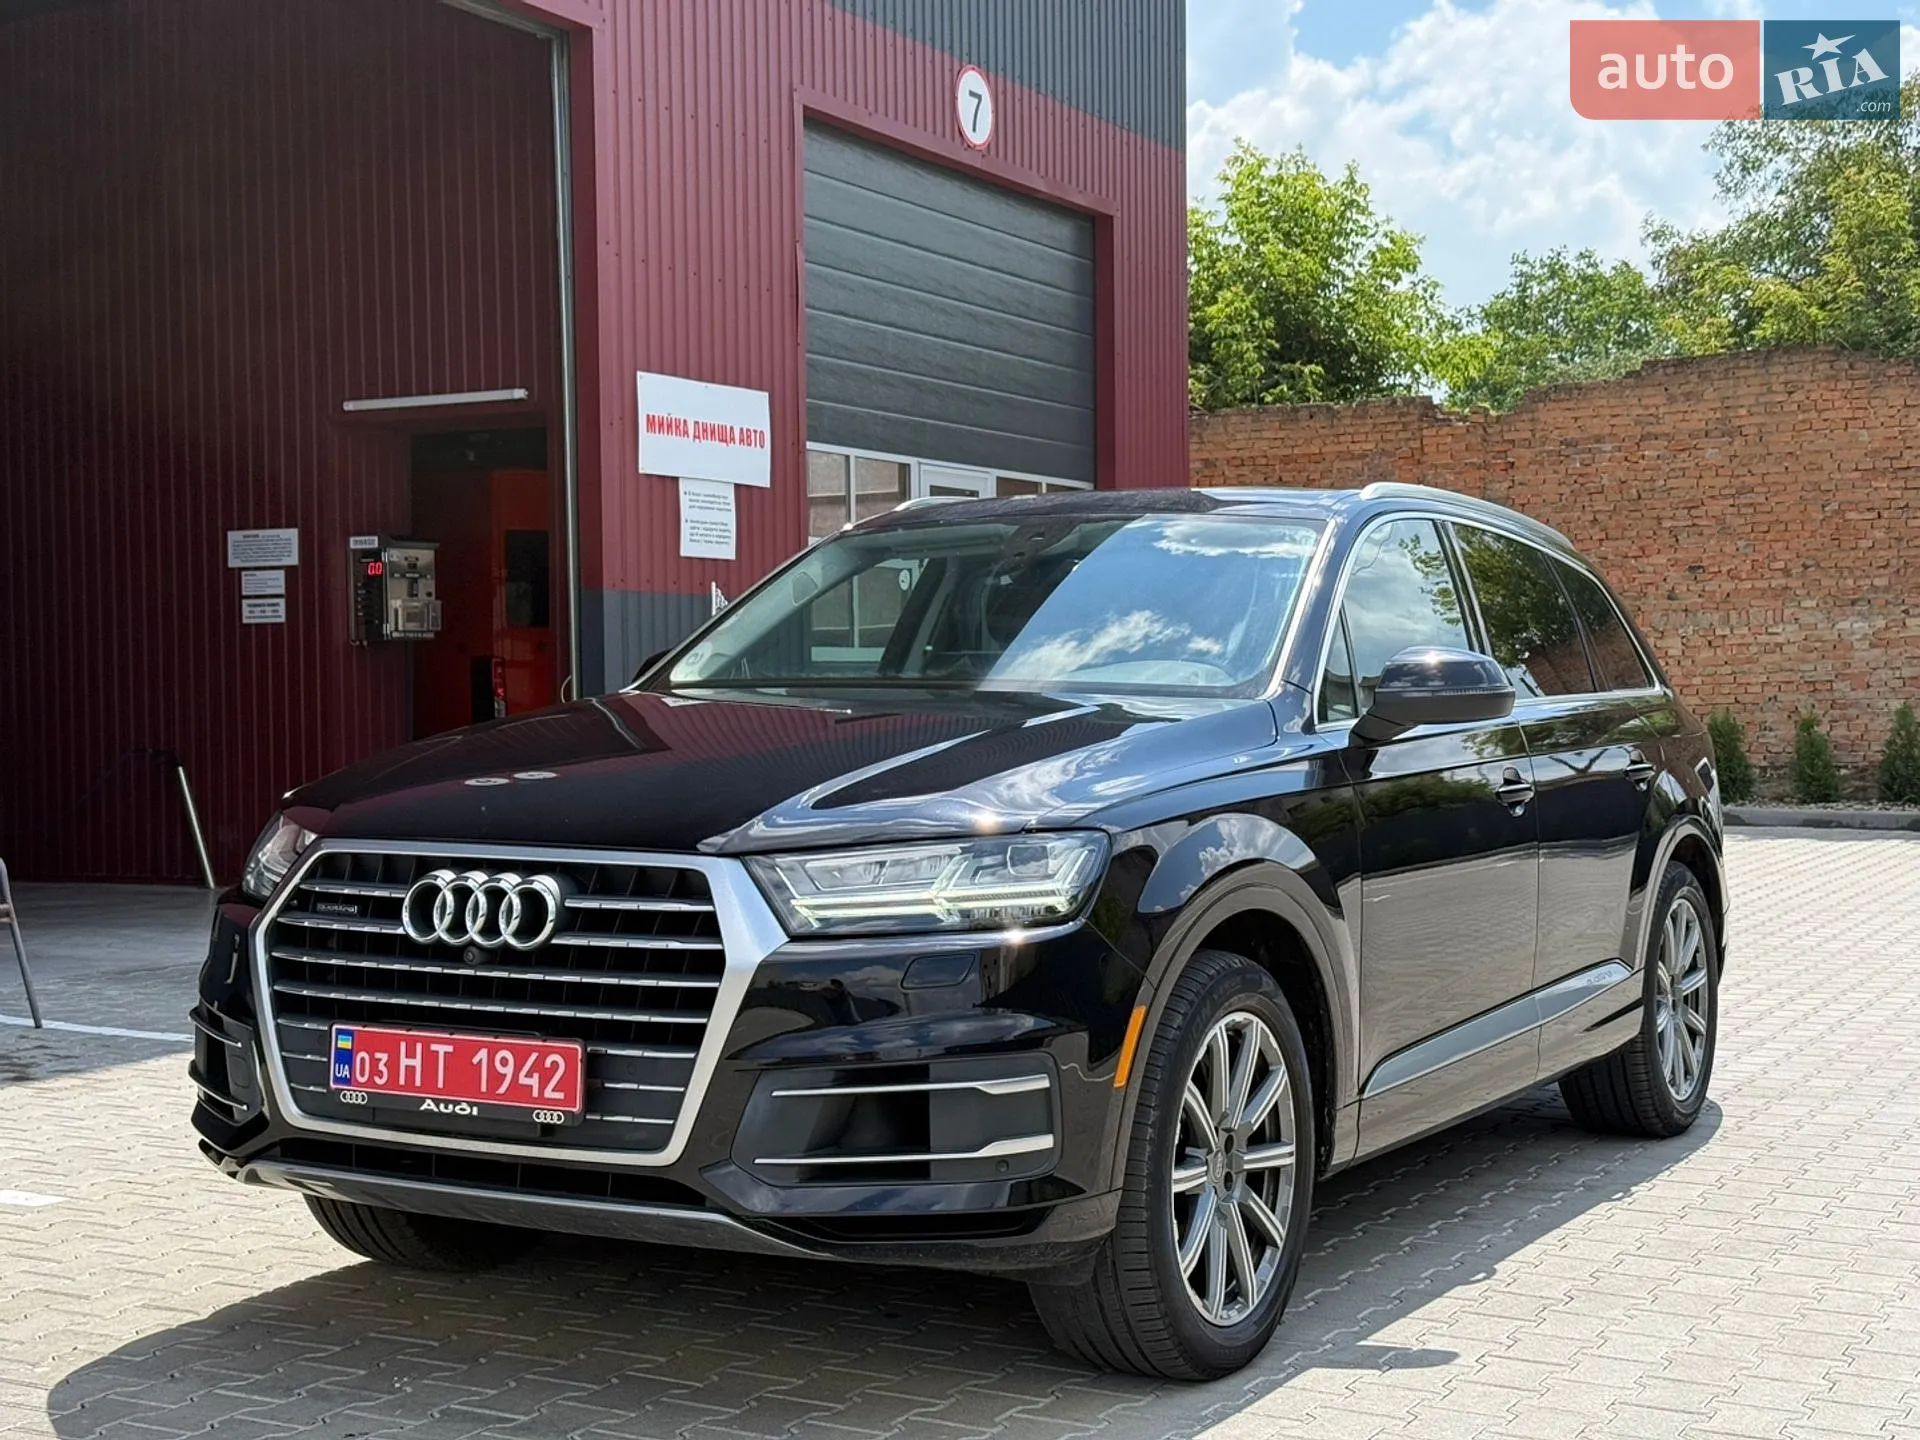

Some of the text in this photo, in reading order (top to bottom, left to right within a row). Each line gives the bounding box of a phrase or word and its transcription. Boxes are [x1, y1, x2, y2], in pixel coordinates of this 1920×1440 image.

[968, 89, 983, 133] 7
[646, 412, 766, 449] МИЙКА ДНИЩА АВТО
[335, 1063, 351, 1080] UA
[471, 1047, 566, 1101] 1942
[419, 1098, 479, 1116] Audi
